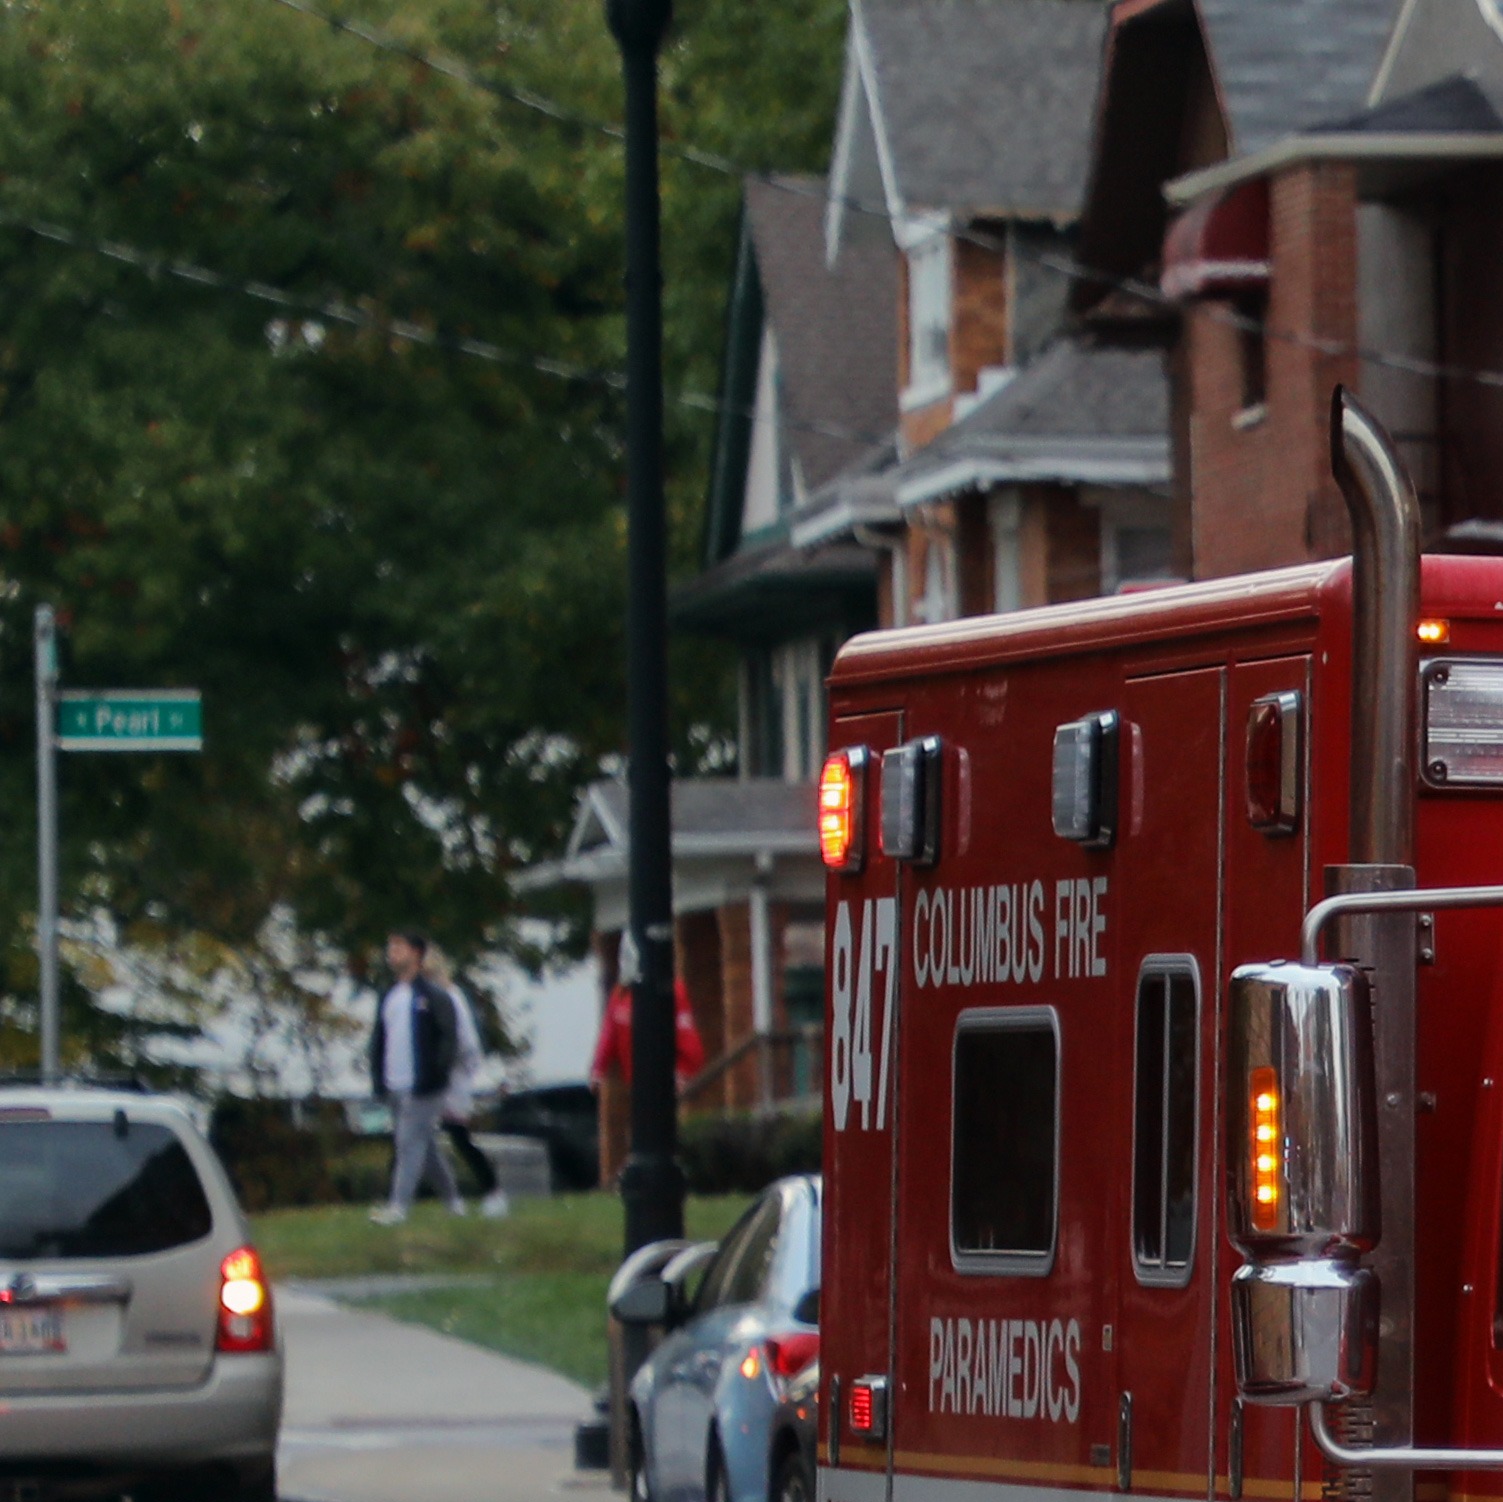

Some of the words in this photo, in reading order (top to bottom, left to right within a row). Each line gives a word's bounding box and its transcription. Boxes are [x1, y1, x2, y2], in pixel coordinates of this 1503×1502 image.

[913, 879, 1044, 990] COLUMBUS
[1055, 876, 1108, 980] FIRE
[831, 897, 896, 1132] 847
[929, 1317, 1081, 1423] PARAMEDICS
